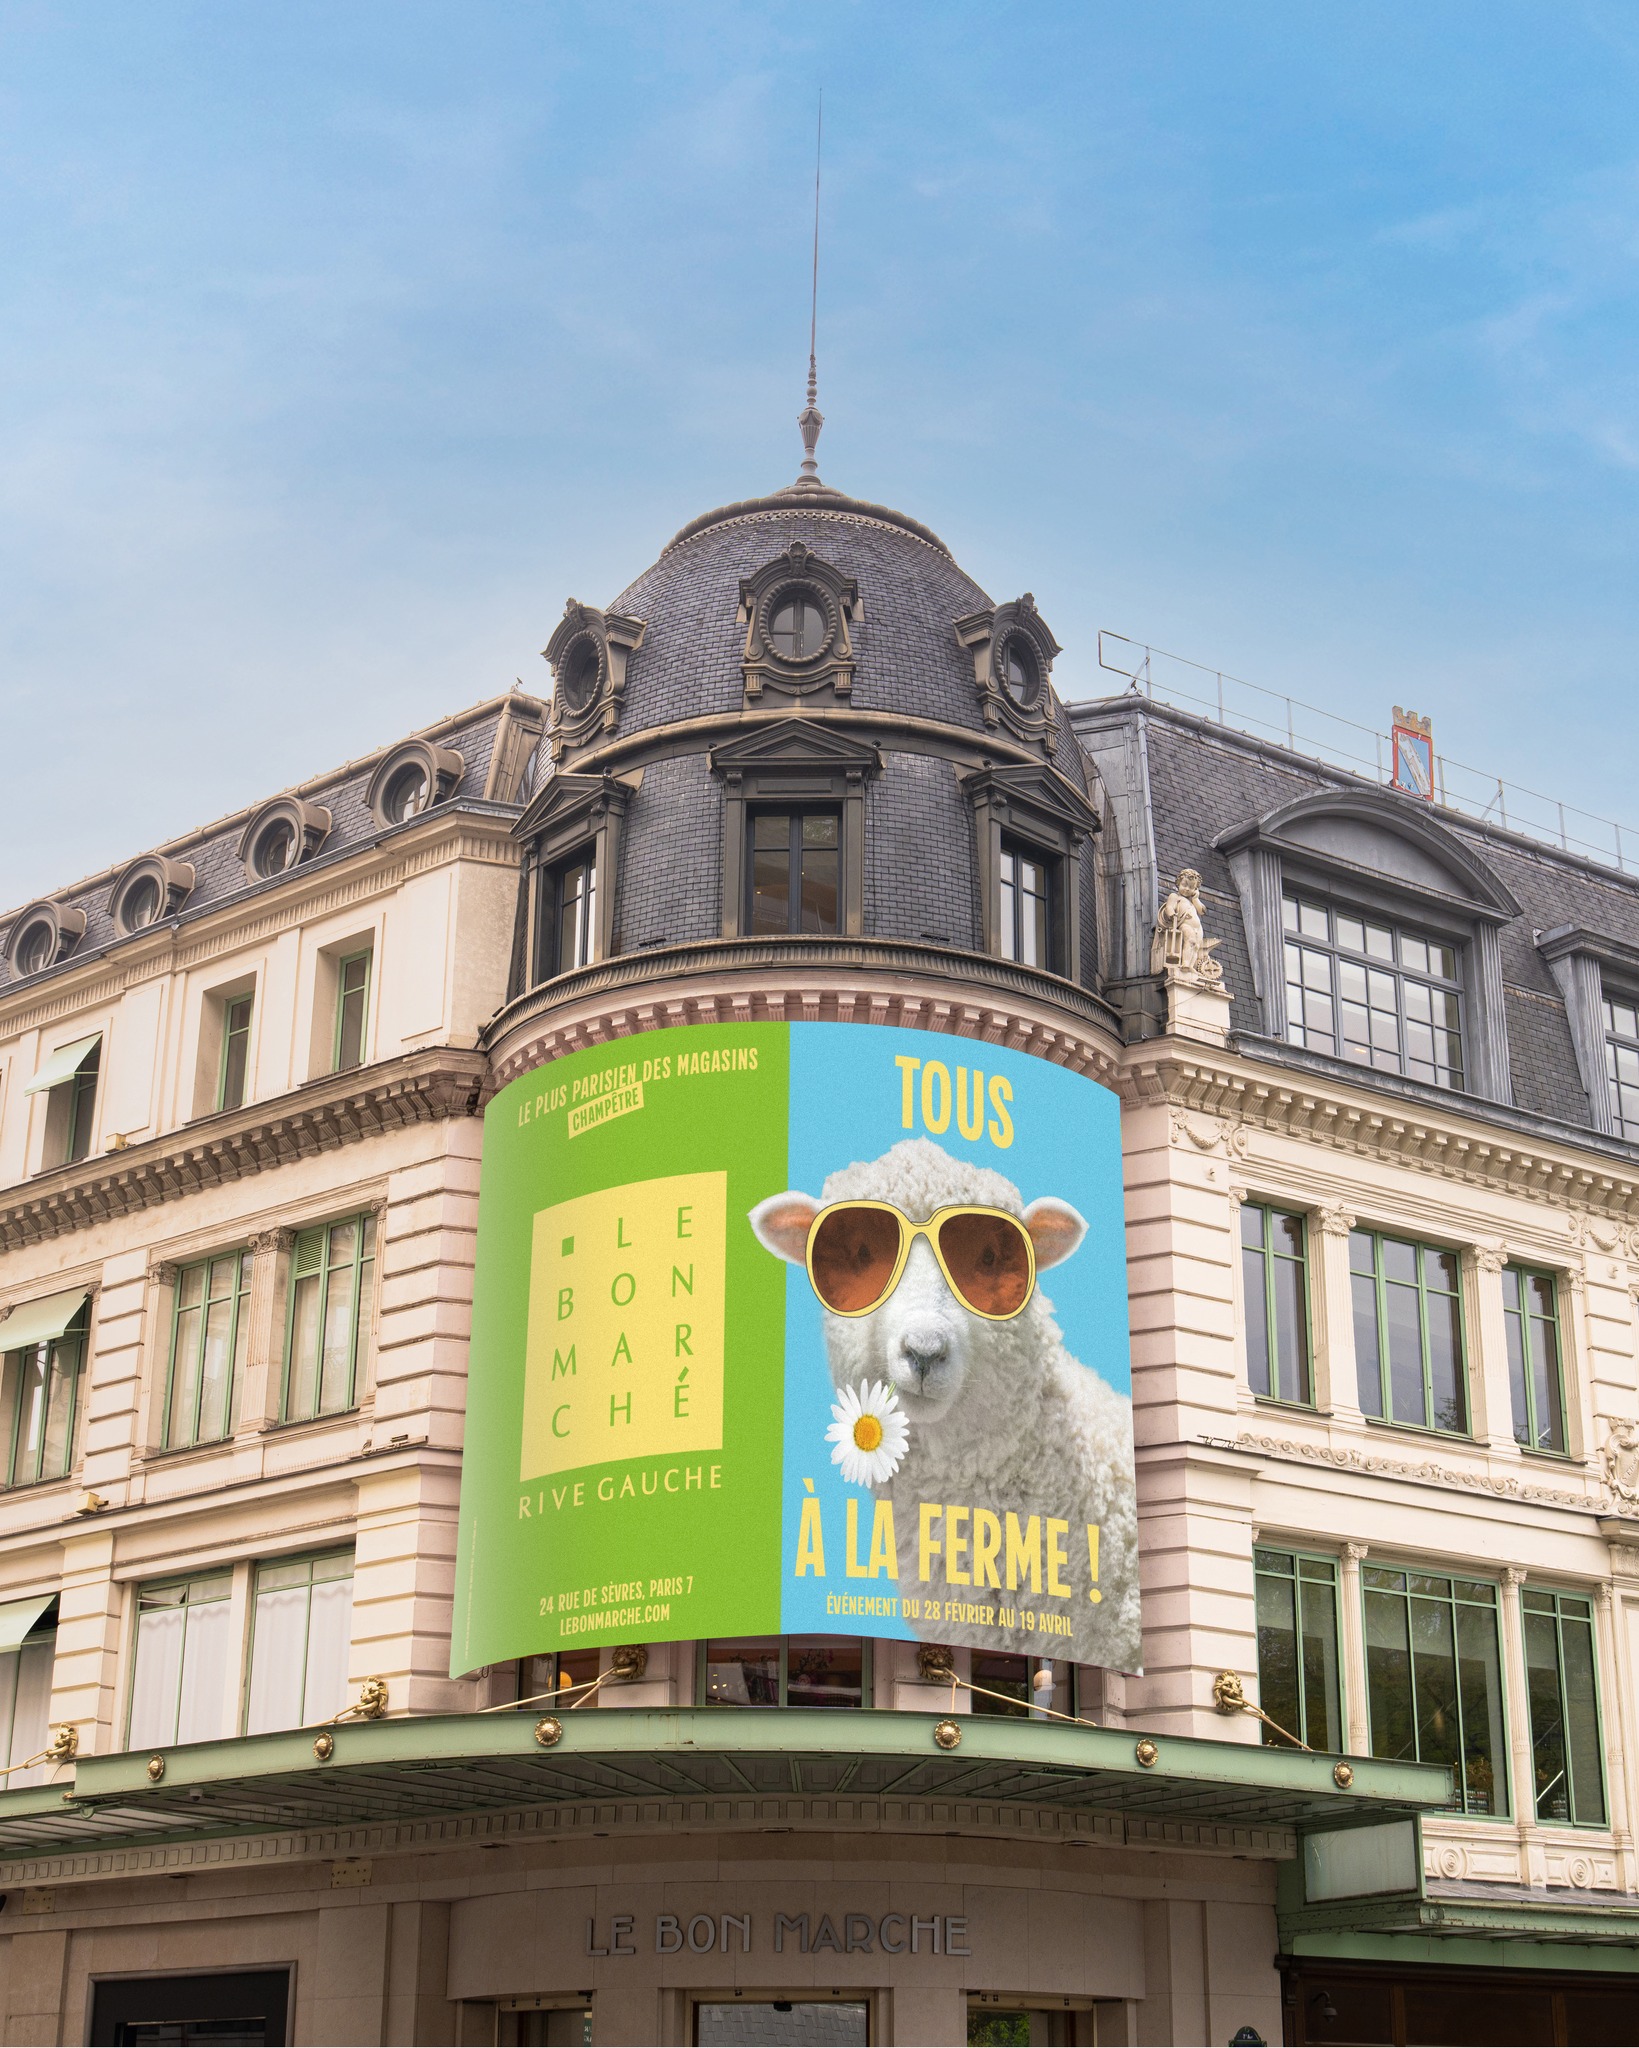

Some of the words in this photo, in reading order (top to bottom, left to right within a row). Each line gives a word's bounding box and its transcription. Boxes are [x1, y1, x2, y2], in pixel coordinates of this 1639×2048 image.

[518, 1100, 532, 1128] LE
[535, 1085, 567, 1119] PLUS
[572, 1063, 637, 1103] PARISIEN
[643, 1057, 671, 1083] DES
[677, 1047, 759, 1077] MAGASINS
[571, 1087, 640, 1132] CHAMPÊTRE
[895, 1055, 1014, 1149] TOUS
[518, 1483, 585, 1520] RIVE
[597, 1465, 723, 1502] GAUCHE
[794, 1477, 826, 1577] À
[846, 1498, 899, 1580] LA
[918, 1502, 1072, 1599] FERME
[539, 1596, 554, 1617] 24
[558, 1590, 580, 1612] RUE
[583, 1588, 597, 1608] DE
[601, 1581, 645, 1605] SÈVRES,
[650, 1577, 683, 1598] PARIS
[686, 1576, 694, 1594] 7
[559, 1603, 671, 1636] LEBONMARCHE.COM
[826, 1591, 898, 1617] ÉVÉNEMENT
[902, 1599, 920, 1619] DU
[924, 1600, 941, 1621] 28
[945, 1598, 994, 1627] FÉVRIER
[998, 1607, 1015, 1629] AU
[1020, 1610, 1035, 1632] 19
[1039, 1613, 1074, 1637] AVRIL
[586, 1915, 637, 1957] LE
[655, 1914, 751, 1955] BON
[774, 1913, 972, 1957] MARCHE
